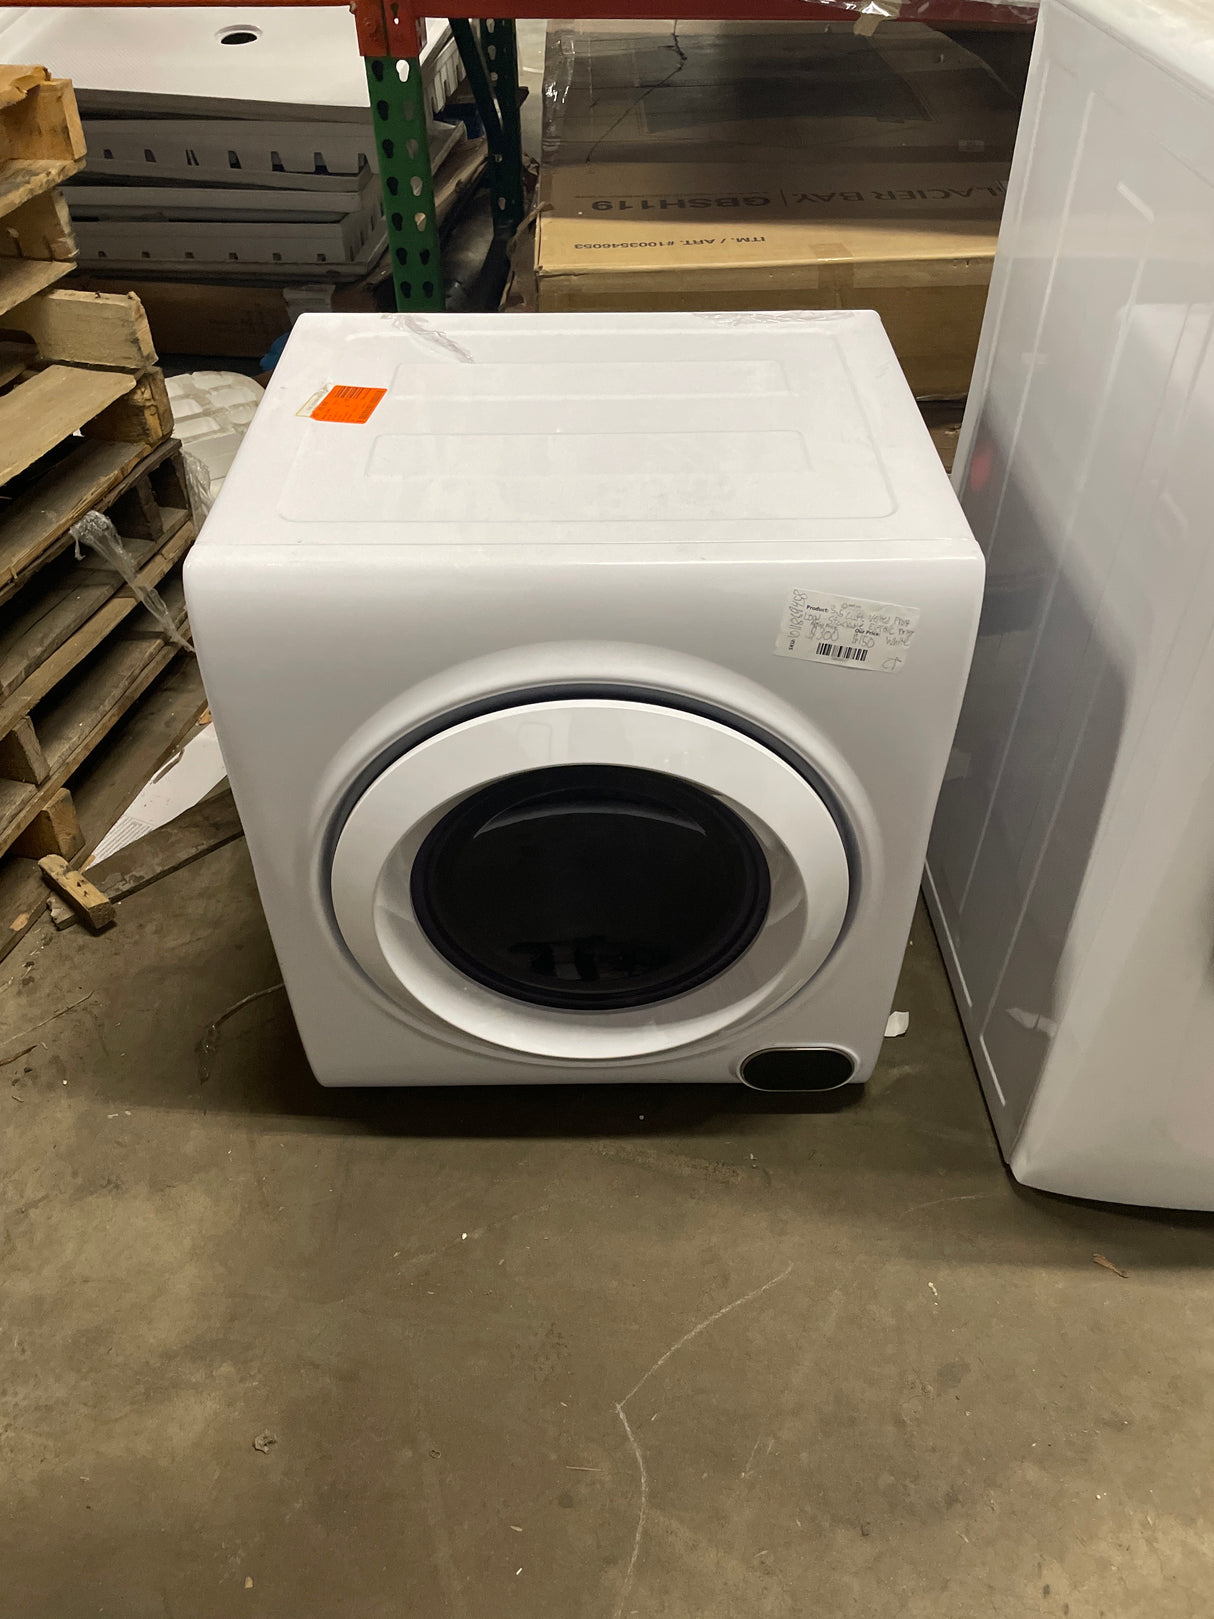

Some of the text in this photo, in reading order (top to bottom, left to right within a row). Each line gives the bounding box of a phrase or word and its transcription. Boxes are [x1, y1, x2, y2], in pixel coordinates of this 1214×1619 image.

[872, 186, 1003, 202] LACIER
[591, 194, 771, 212] GBSH119
[574, 239, 675, 250] #1003546053
[680, 237, 715, 247] ART.
[731, 235, 766, 245] ITM.
[806, 604, 829, 613] Product:
